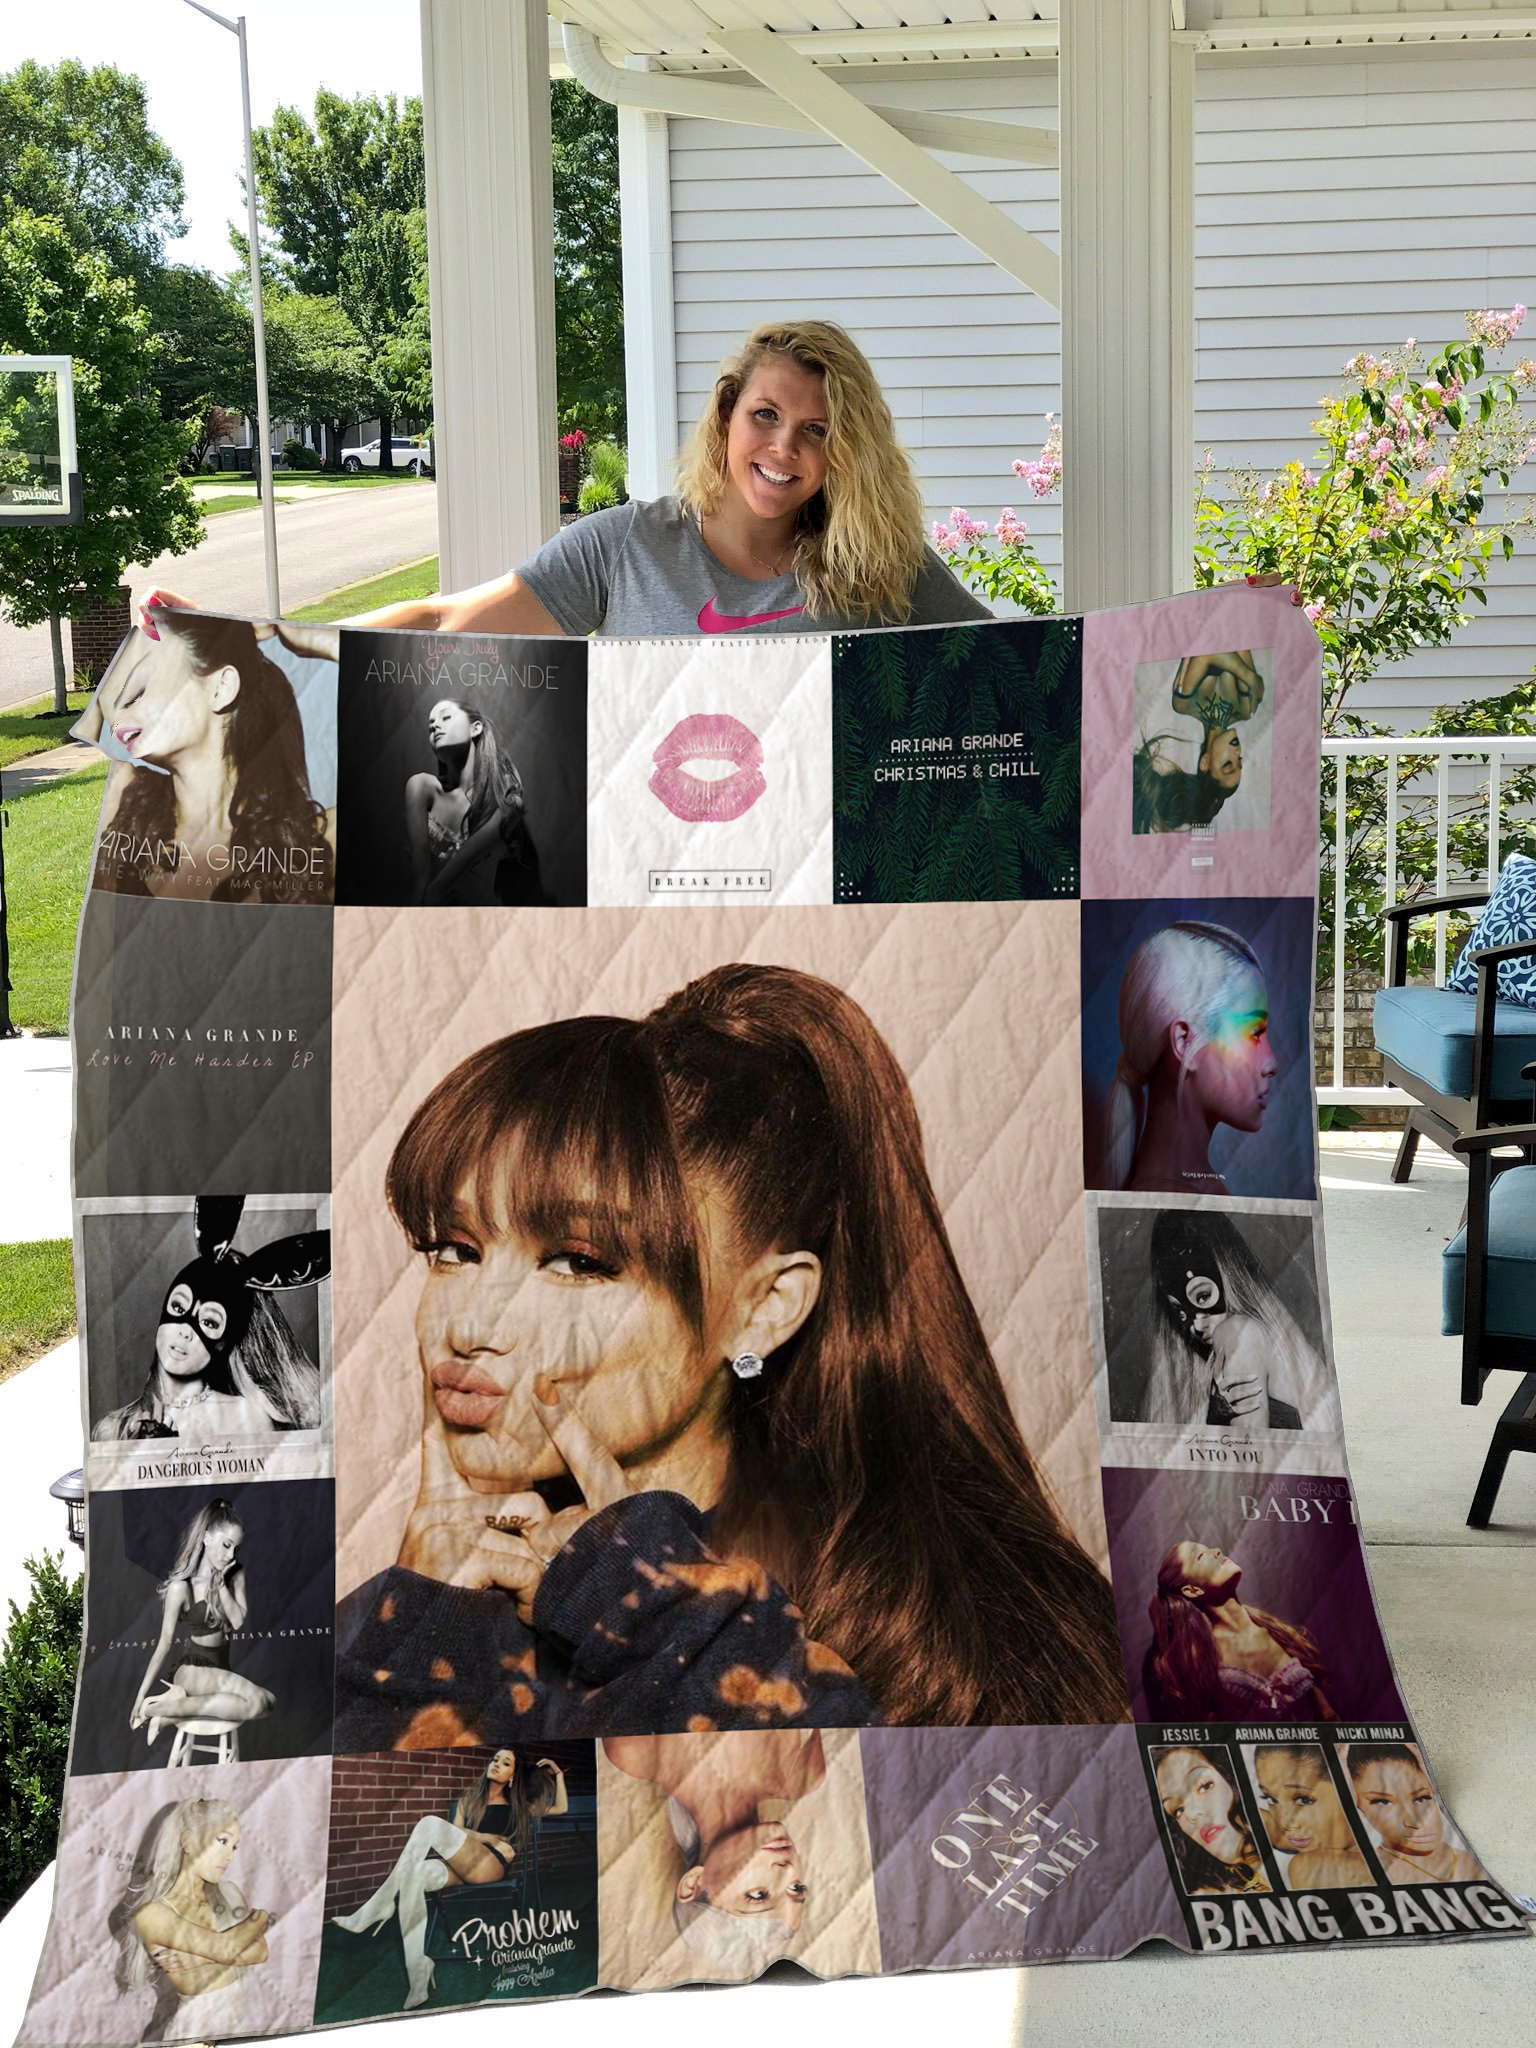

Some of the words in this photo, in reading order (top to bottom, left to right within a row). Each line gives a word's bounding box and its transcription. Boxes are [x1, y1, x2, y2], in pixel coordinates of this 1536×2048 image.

[12, 489, 61, 502] SPALDING
[422, 635, 460, 670] Yours
[463, 637, 499, 664] Truly
[712, 638, 786, 647] FEATURING
[364, 659, 453, 686] ARIANA
[459, 662, 559, 690] GRANDE
[891, 737, 953, 754] ARIANA
[961, 732, 1024, 750] GRANDE
[874, 764, 967, 782] CHRISTMAS
[972, 763, 983, 779] &
[989, 761, 1041, 777] CHILL
[99, 830, 197, 869] ARIANA
[206, 843, 325, 875] GRANDE
[101, 861, 124, 879] HE
[138, 868, 179, 884] WAY
[187, 875, 221, 887] FEAT
[230, 879, 263, 890] MAC
[272, 880, 325, 891] MILLER
[655, 877, 710, 887] BREAK
[724, 877, 766, 886] FREE
[104, 1026, 193, 1042] ARIANA
[206, 1028, 298, 1043] GRANDE
[86, 1049, 132, 1068] Love
[150, 1050, 177, 1070] Me
[194, 1052, 274, 1068] Harder
[291, 1051, 315, 1070] EP
[1189, 1449, 1228, 1463] INTO
[1232, 1450, 1264, 1465] YOU
[138, 1461, 213, 1480] DANGEROUS
[217, 1458, 266, 1475] WOMAN
[1297, 1482, 1352, 1499] GRAND
[1237, 1495, 1336, 1525] BABY
[224, 1631, 272, 1641] ARIANA
[280, 1627, 332, 1637] GRANDE
[1163, 1728, 1200, 1742] JESSIE
[1204, 1728, 1210, 1741] J
[1235, 1727, 1275, 1741] ARIANA
[1276, 1727, 1320, 1741] GRANDE
[1335, 1727, 1368, 1741] NICKI
[1370, 1727, 1405, 1740] MINAJ
[930, 1773, 1034, 1869] ONE
[86, 1846, 144, 1863] ARIANA
[962, 1802, 1064, 1900] LAST
[995, 1828, 1100, 1919] TIME
[1191, 1895, 1343, 1951] BANG
[1347, 1885, 1525, 1938] BANG
[451, 1907, 580, 1959] Problem
[967, 1949, 1024, 1960] ARIANA
[1033, 1945, 1097, 1956] GRANDE
